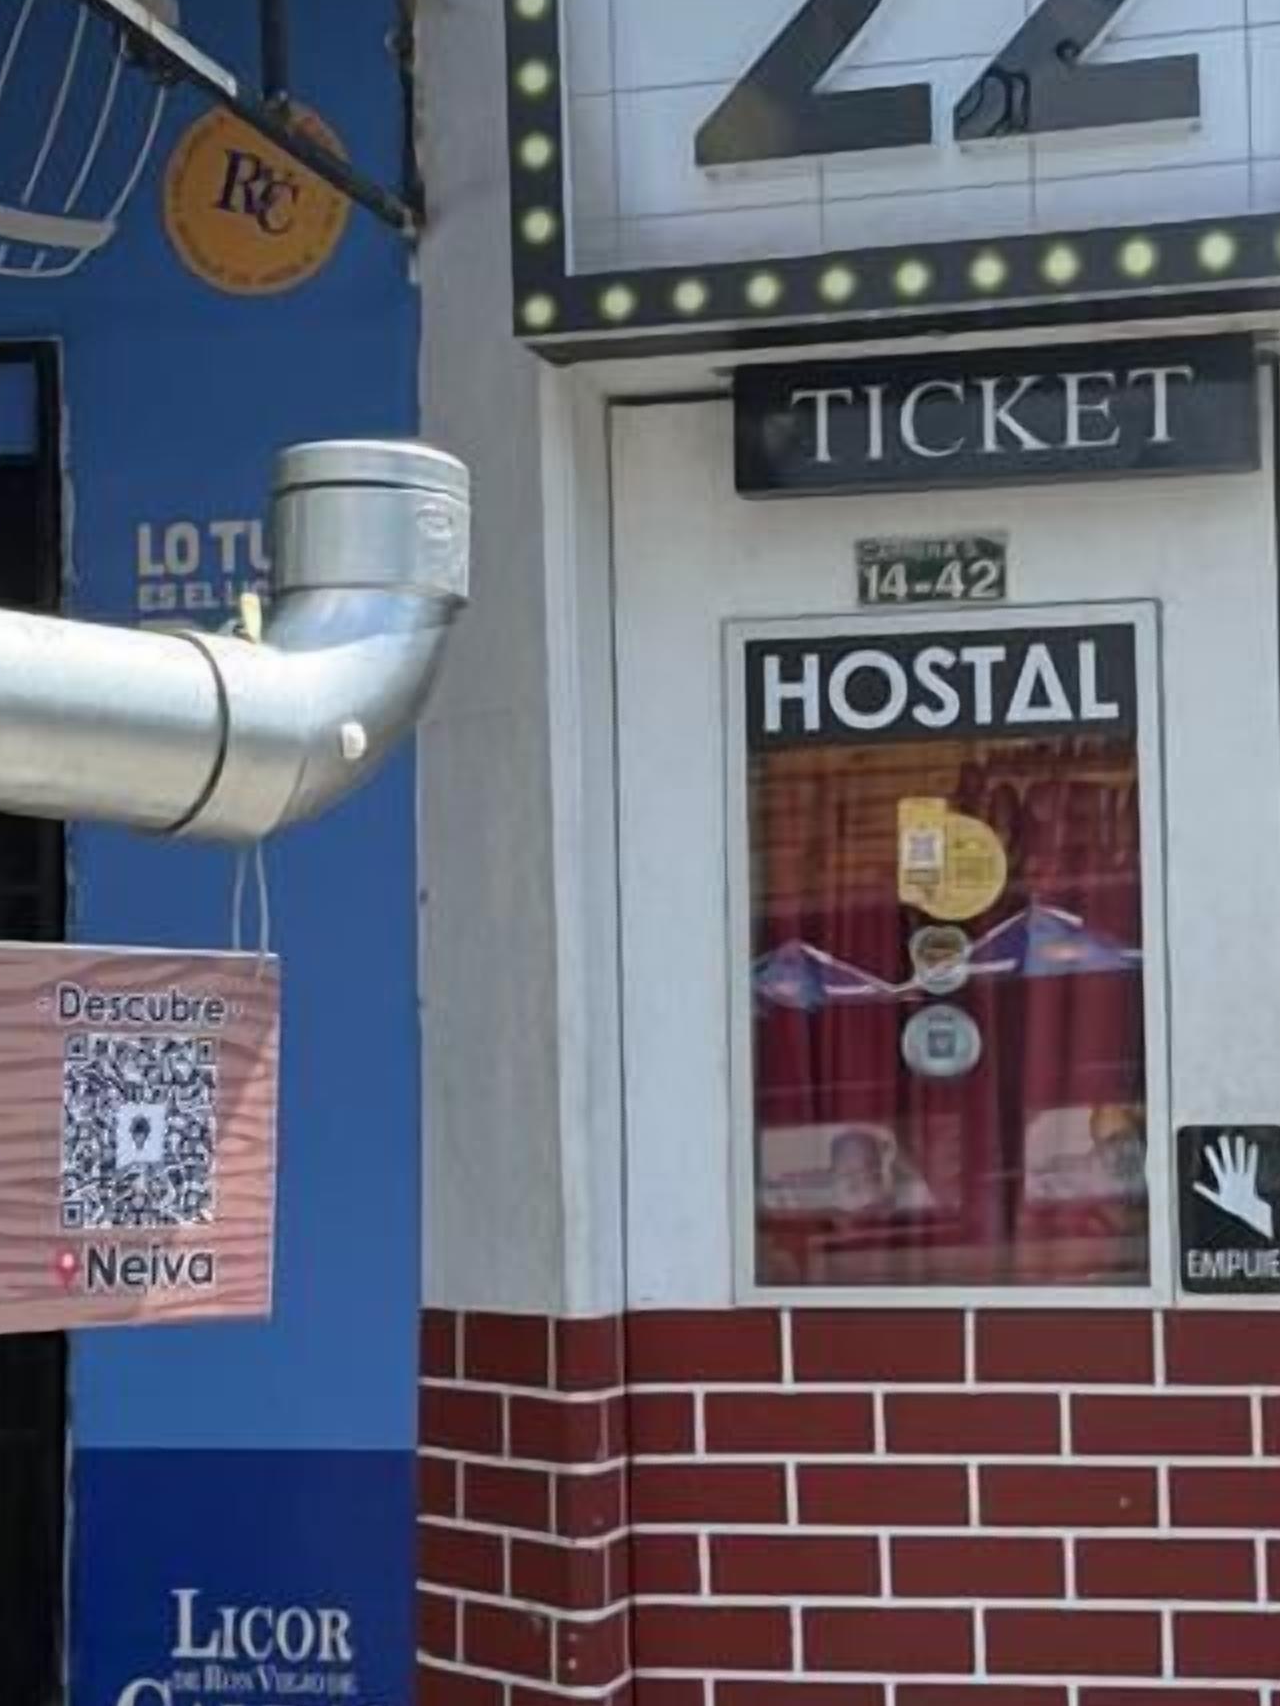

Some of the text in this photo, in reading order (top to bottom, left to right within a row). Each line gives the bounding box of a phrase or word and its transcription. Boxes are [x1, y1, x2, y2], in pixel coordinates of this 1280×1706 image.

[791, 365, 1193, 464] TICKET
[137, 521, 199, 576] LO
[864, 558, 998, 599] 14-42
[761, 639, 1119, 734] HOSTAL
[58, 985, 225, 1023] Descubre
[86, 1245, 215, 1288] Neiva
[170, 1588, 353, 1663] LICOR
